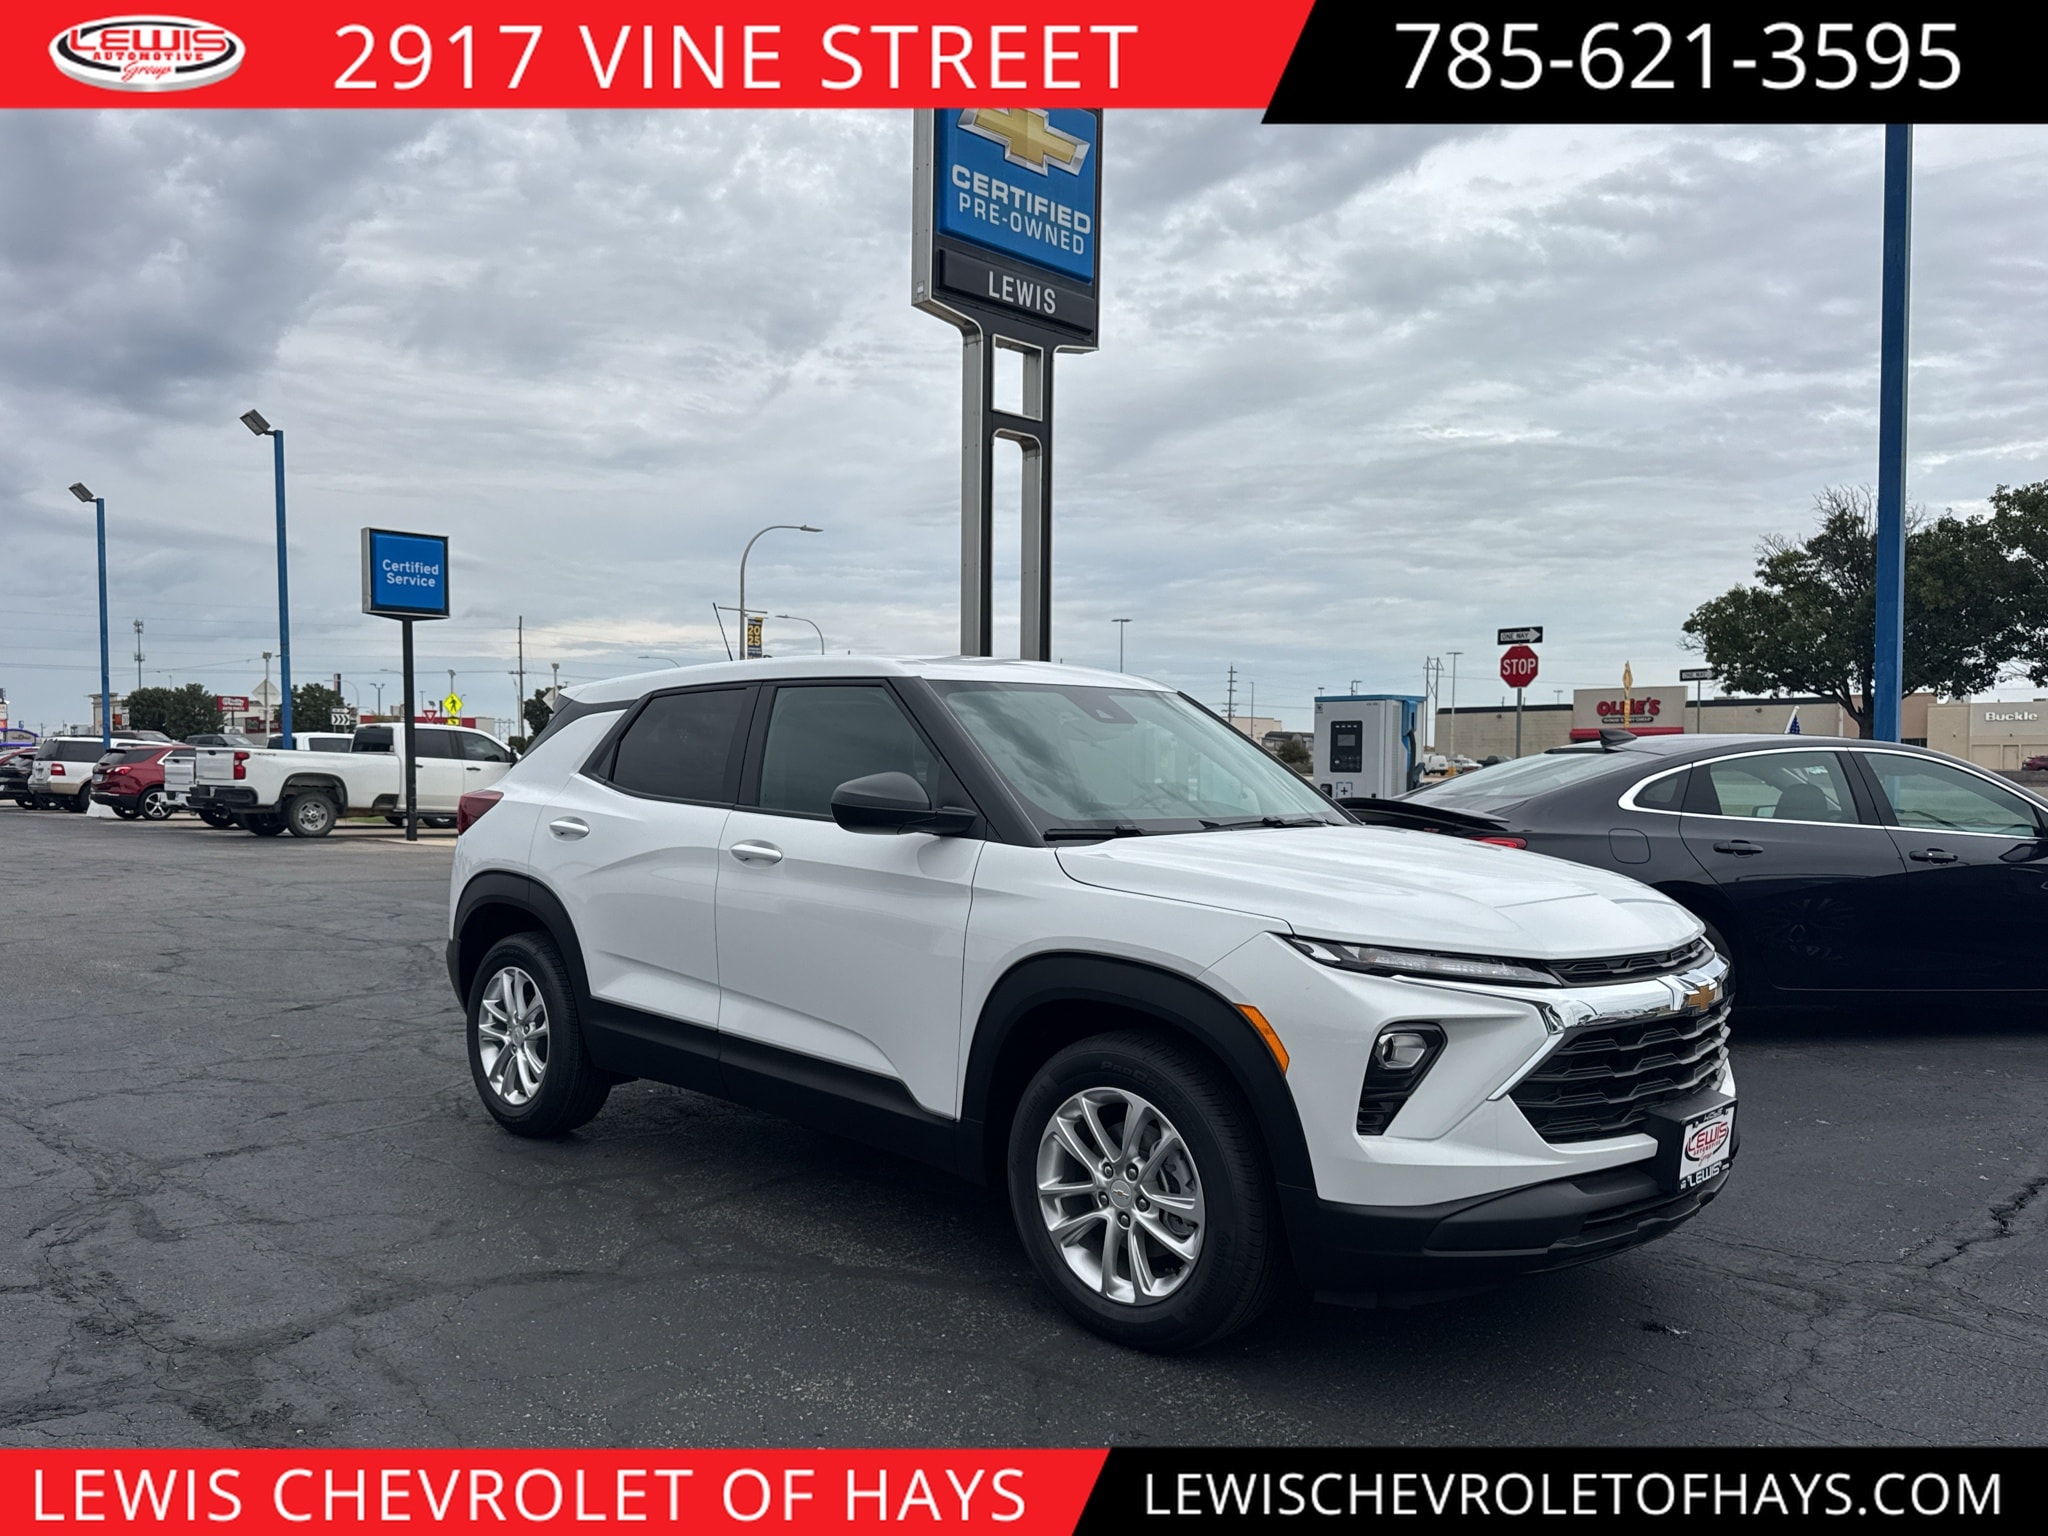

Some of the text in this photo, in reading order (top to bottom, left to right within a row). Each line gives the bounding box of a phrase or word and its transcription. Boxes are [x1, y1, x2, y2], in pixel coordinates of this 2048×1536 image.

[952, 164, 1091, 235] CERTIFIED
[959, 191, 1085, 255] PRE-OWNED
[988, 270, 1057, 314] LEWIS
[382, 559, 439, 575] Certified
[386, 572, 436, 587] Service
[1516, 632, 1529, 640] WAY
[1502, 658, 1536, 675] STOP
[1985, 711, 2038, 721] Buckle
[1687, 1121, 1728, 1152] LEWIS
[1688, 1161, 1722, 1187] LEWIS
